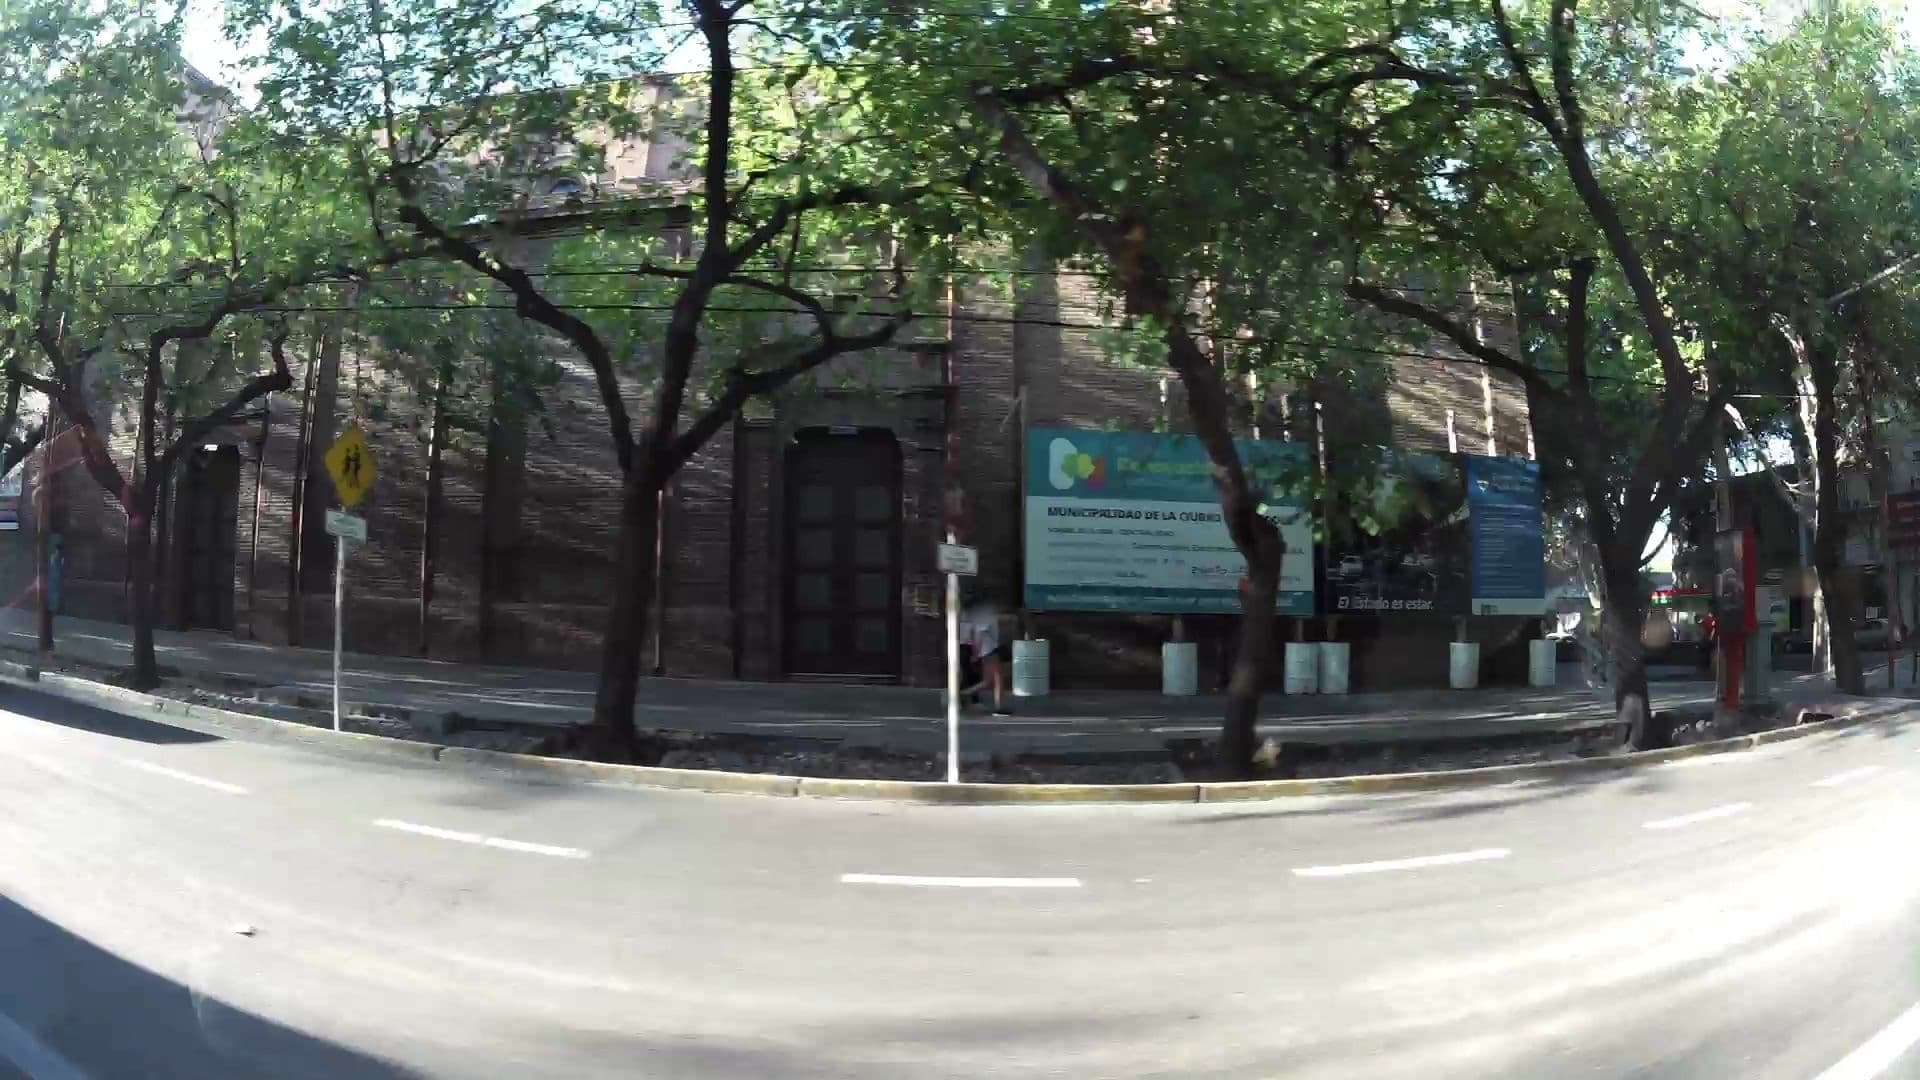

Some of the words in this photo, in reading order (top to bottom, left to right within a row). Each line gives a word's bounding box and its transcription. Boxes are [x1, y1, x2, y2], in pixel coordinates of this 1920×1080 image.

[1048, 507, 1142, 520] MUNICIPALIDAD
[1144, 510, 1160, 520] DE
[1162, 511, 1177, 521] LA
[1391, 599, 1404, 609] es
